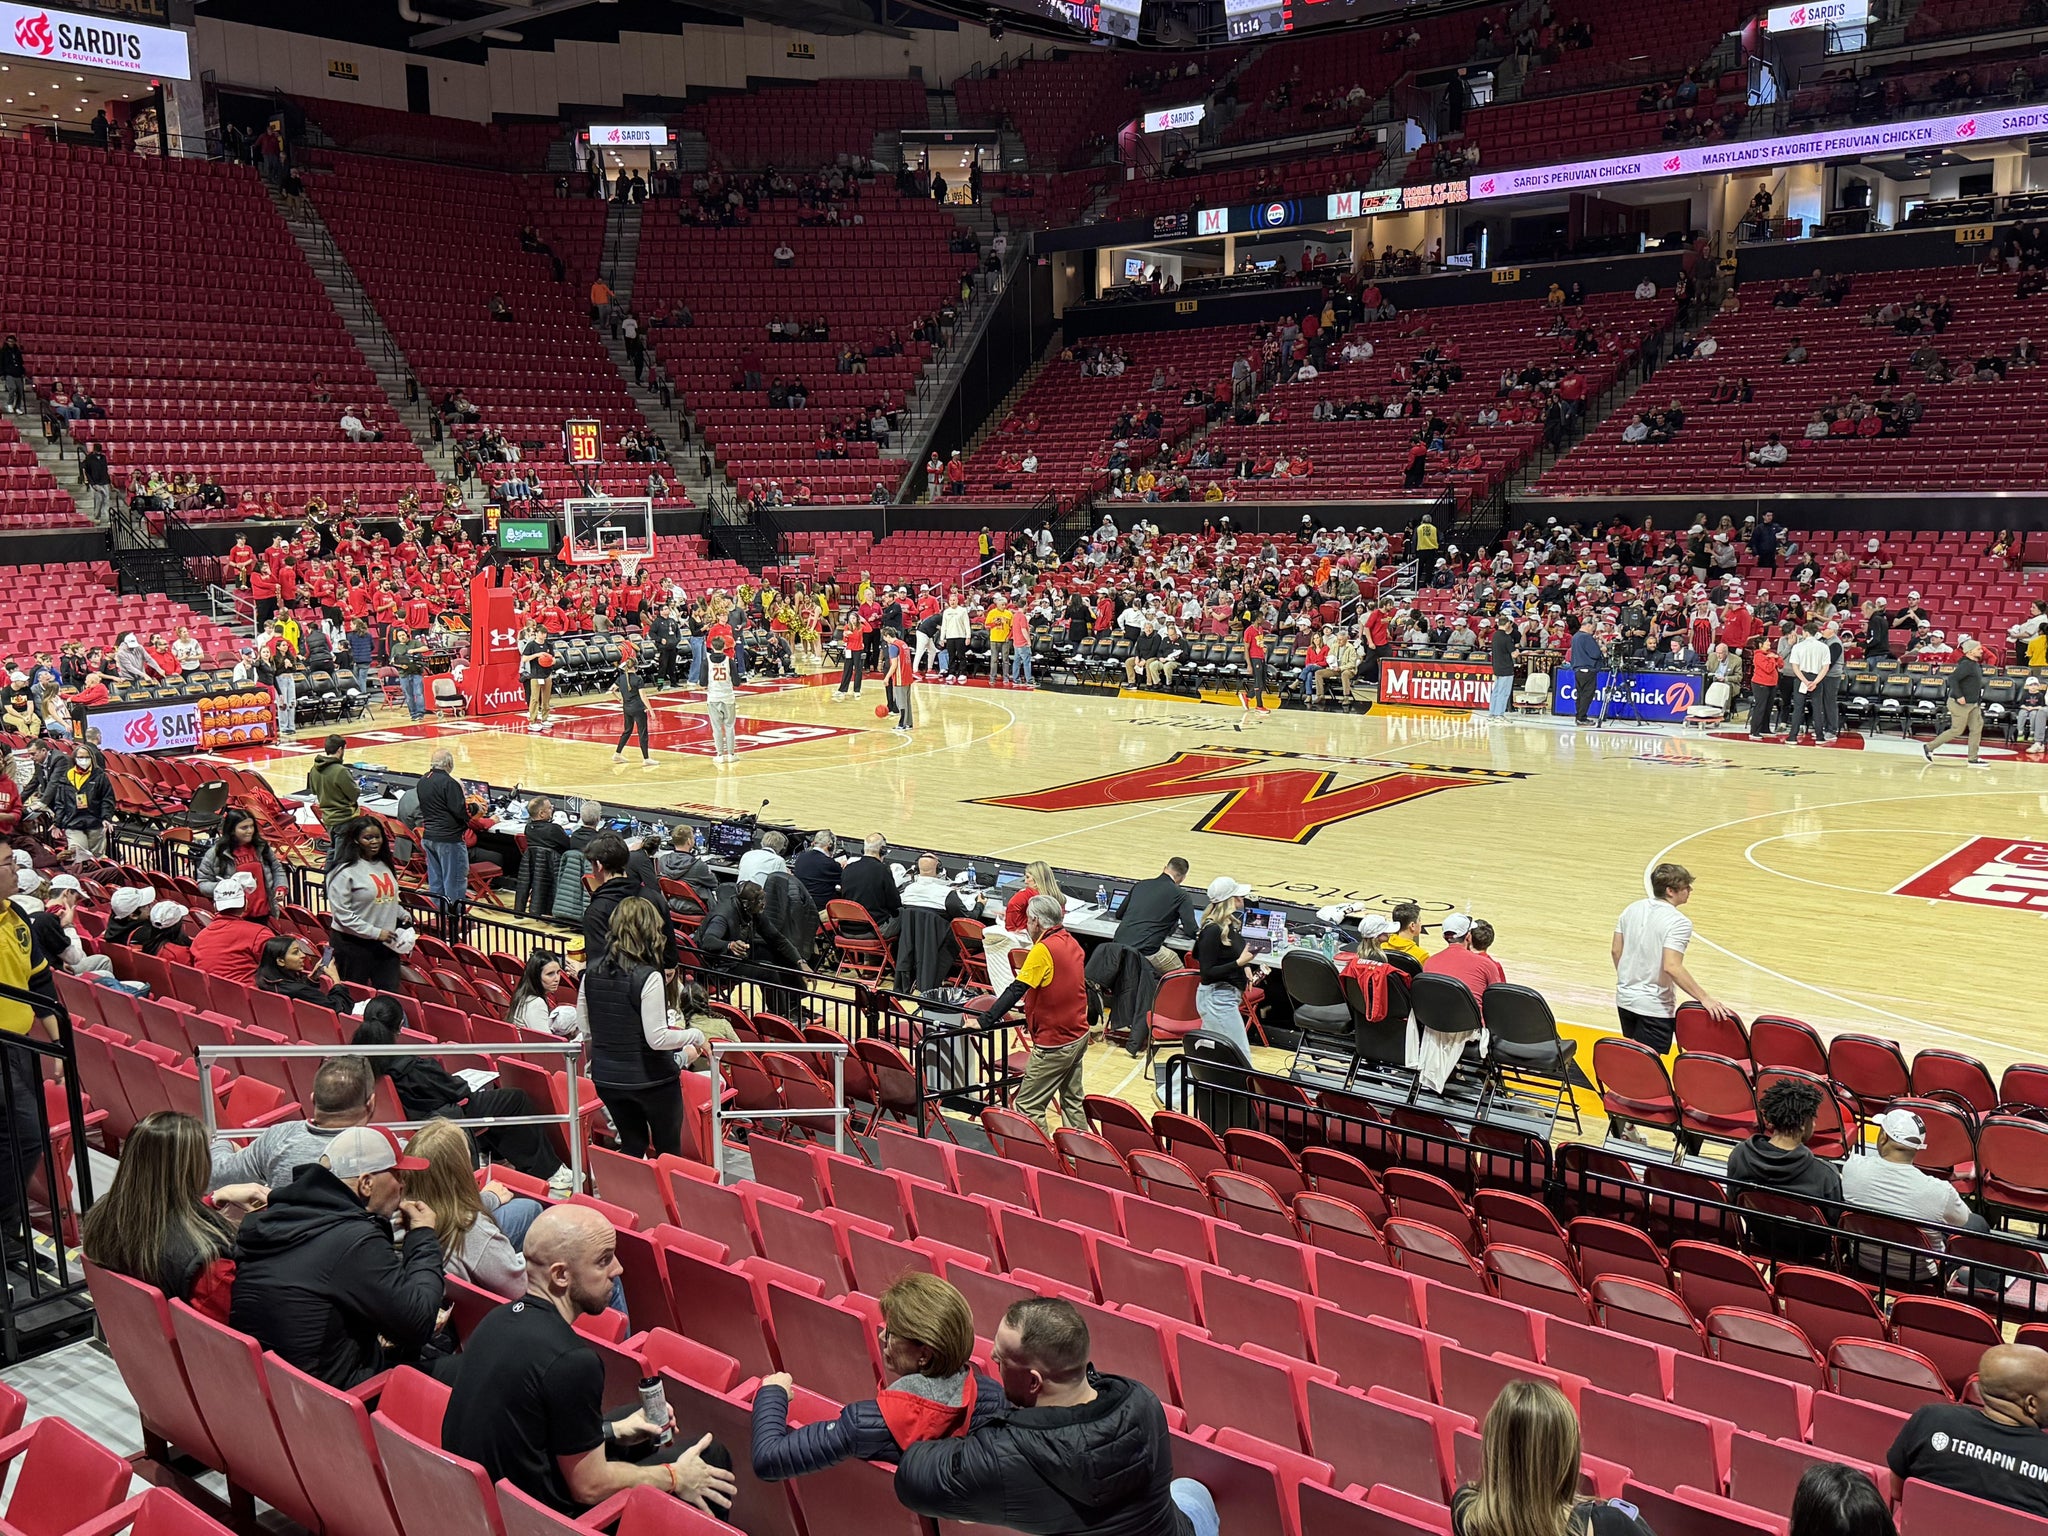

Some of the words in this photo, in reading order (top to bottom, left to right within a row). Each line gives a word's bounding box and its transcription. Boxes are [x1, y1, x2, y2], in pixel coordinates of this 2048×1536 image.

[1808, 4, 1845, 21] SARDI'S
[1232, 20, 1260, 36] 11:14
[58, 23, 141, 61] SARDI'S
[62, 51, 104, 64] PERUVIAN
[105, 58, 141, 69] CHICKEN
[1170, 111, 1195, 125] SARDI'S
[2002, 114, 2048, 130] SARDI'S
[621, 130, 650, 141] SARDI'S
[1702, 147, 1769, 166] MARYLAND'S
[1771, 140, 1823, 157] FAVORITE
[1825, 134, 1880, 150] PERUVIAN
[1882, 127, 1932, 144] CHICKEN
[1513, 174, 1550, 188] SARDI'S
[1551, 168, 1597, 184] PERUVIAN
[1599, 163, 1641, 177] CHICKEN
[1403, 184, 1432, 198] HOME
[1433, 182, 1446, 195] OF
[1448, 180, 1467, 192] THE
[1336, 193, 1353, 216] M
[1403, 191, 1468, 209] TERRAPINS
[1205, 210, 1220, 231] M
[1963, 228, 1985, 241] 114
[1497, 270, 1514, 281] 115
[571, 425, 597, 436] 11:14
[573, 437, 596, 460] 30
[712, 667, 727, 681] 25
[1386, 668, 1410, 695] M
[1416, 670, 1447, 679] HOME
[1454, 671, 1468, 680] OF
[484, 687, 528, 709] xfinit
[1411, 678, 1496, 704] TERRAPIN
[369, 872, 395, 898] M
[1951, 1438, 2016, 1472] TERRAPIN
[2019, 1459, 2048, 1484] ROW
